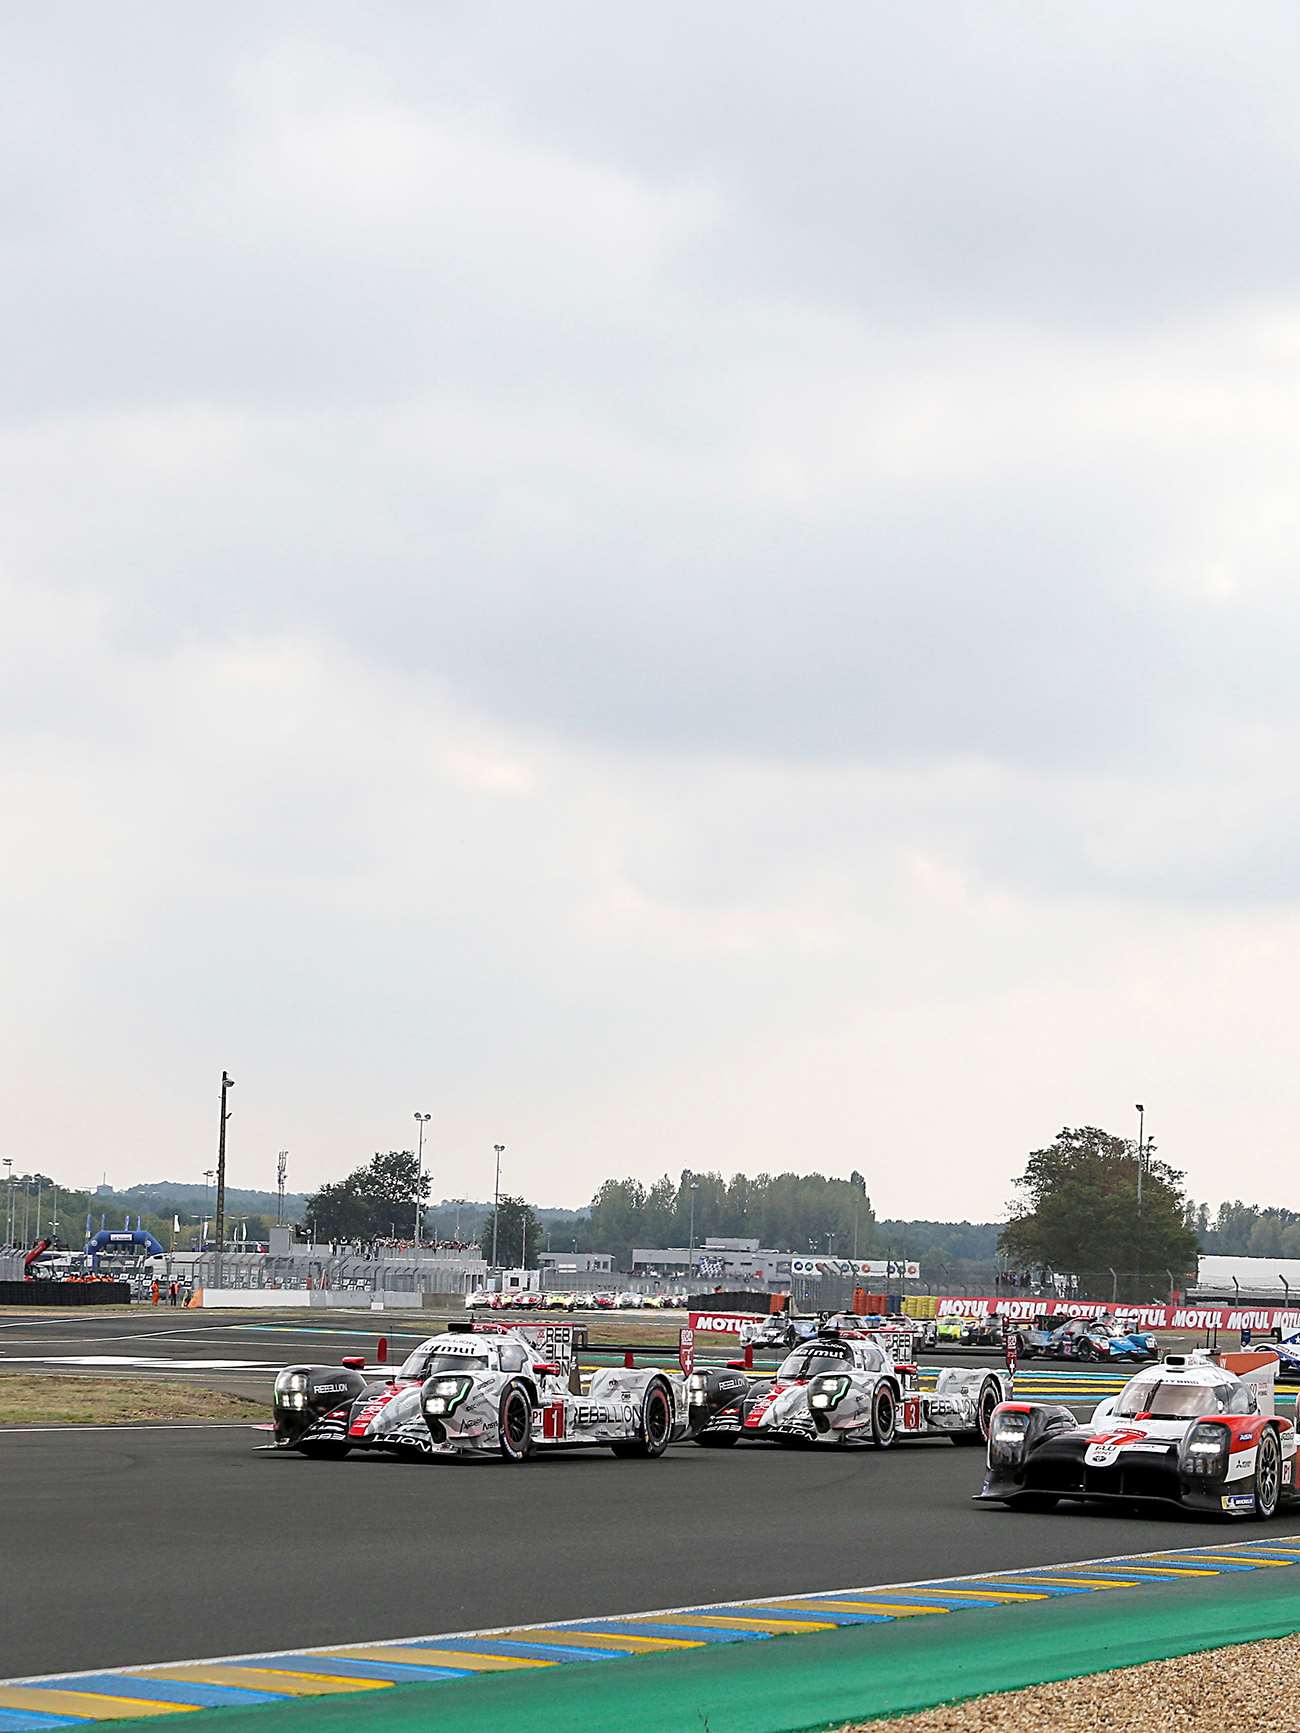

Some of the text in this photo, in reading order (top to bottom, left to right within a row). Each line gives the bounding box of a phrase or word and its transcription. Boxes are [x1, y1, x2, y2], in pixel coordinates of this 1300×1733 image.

[938, 1299, 989, 1317] MOTUL
[996, 1301, 1050, 1319] MOTUL
[1054, 1303, 1108, 1318] MOTUL
[1114, 1307, 1167, 1327] MOTUL
[1172, 1310, 1223, 1329] MOTUL
[1226, 1311, 1270, 1329] MOTUL
[695, 1316, 748, 1334] MOTU
[546, 1327, 570, 1343] REB
[313, 1383, 349, 1395] REBELLION
[909, 1404, 917, 1428] 3
[928, 1400, 979, 1416] EBELLION
[533, 1413, 542, 1424] P1
[551, 1409, 558, 1437] 1
[1104, 1433, 1128, 1445] 7
